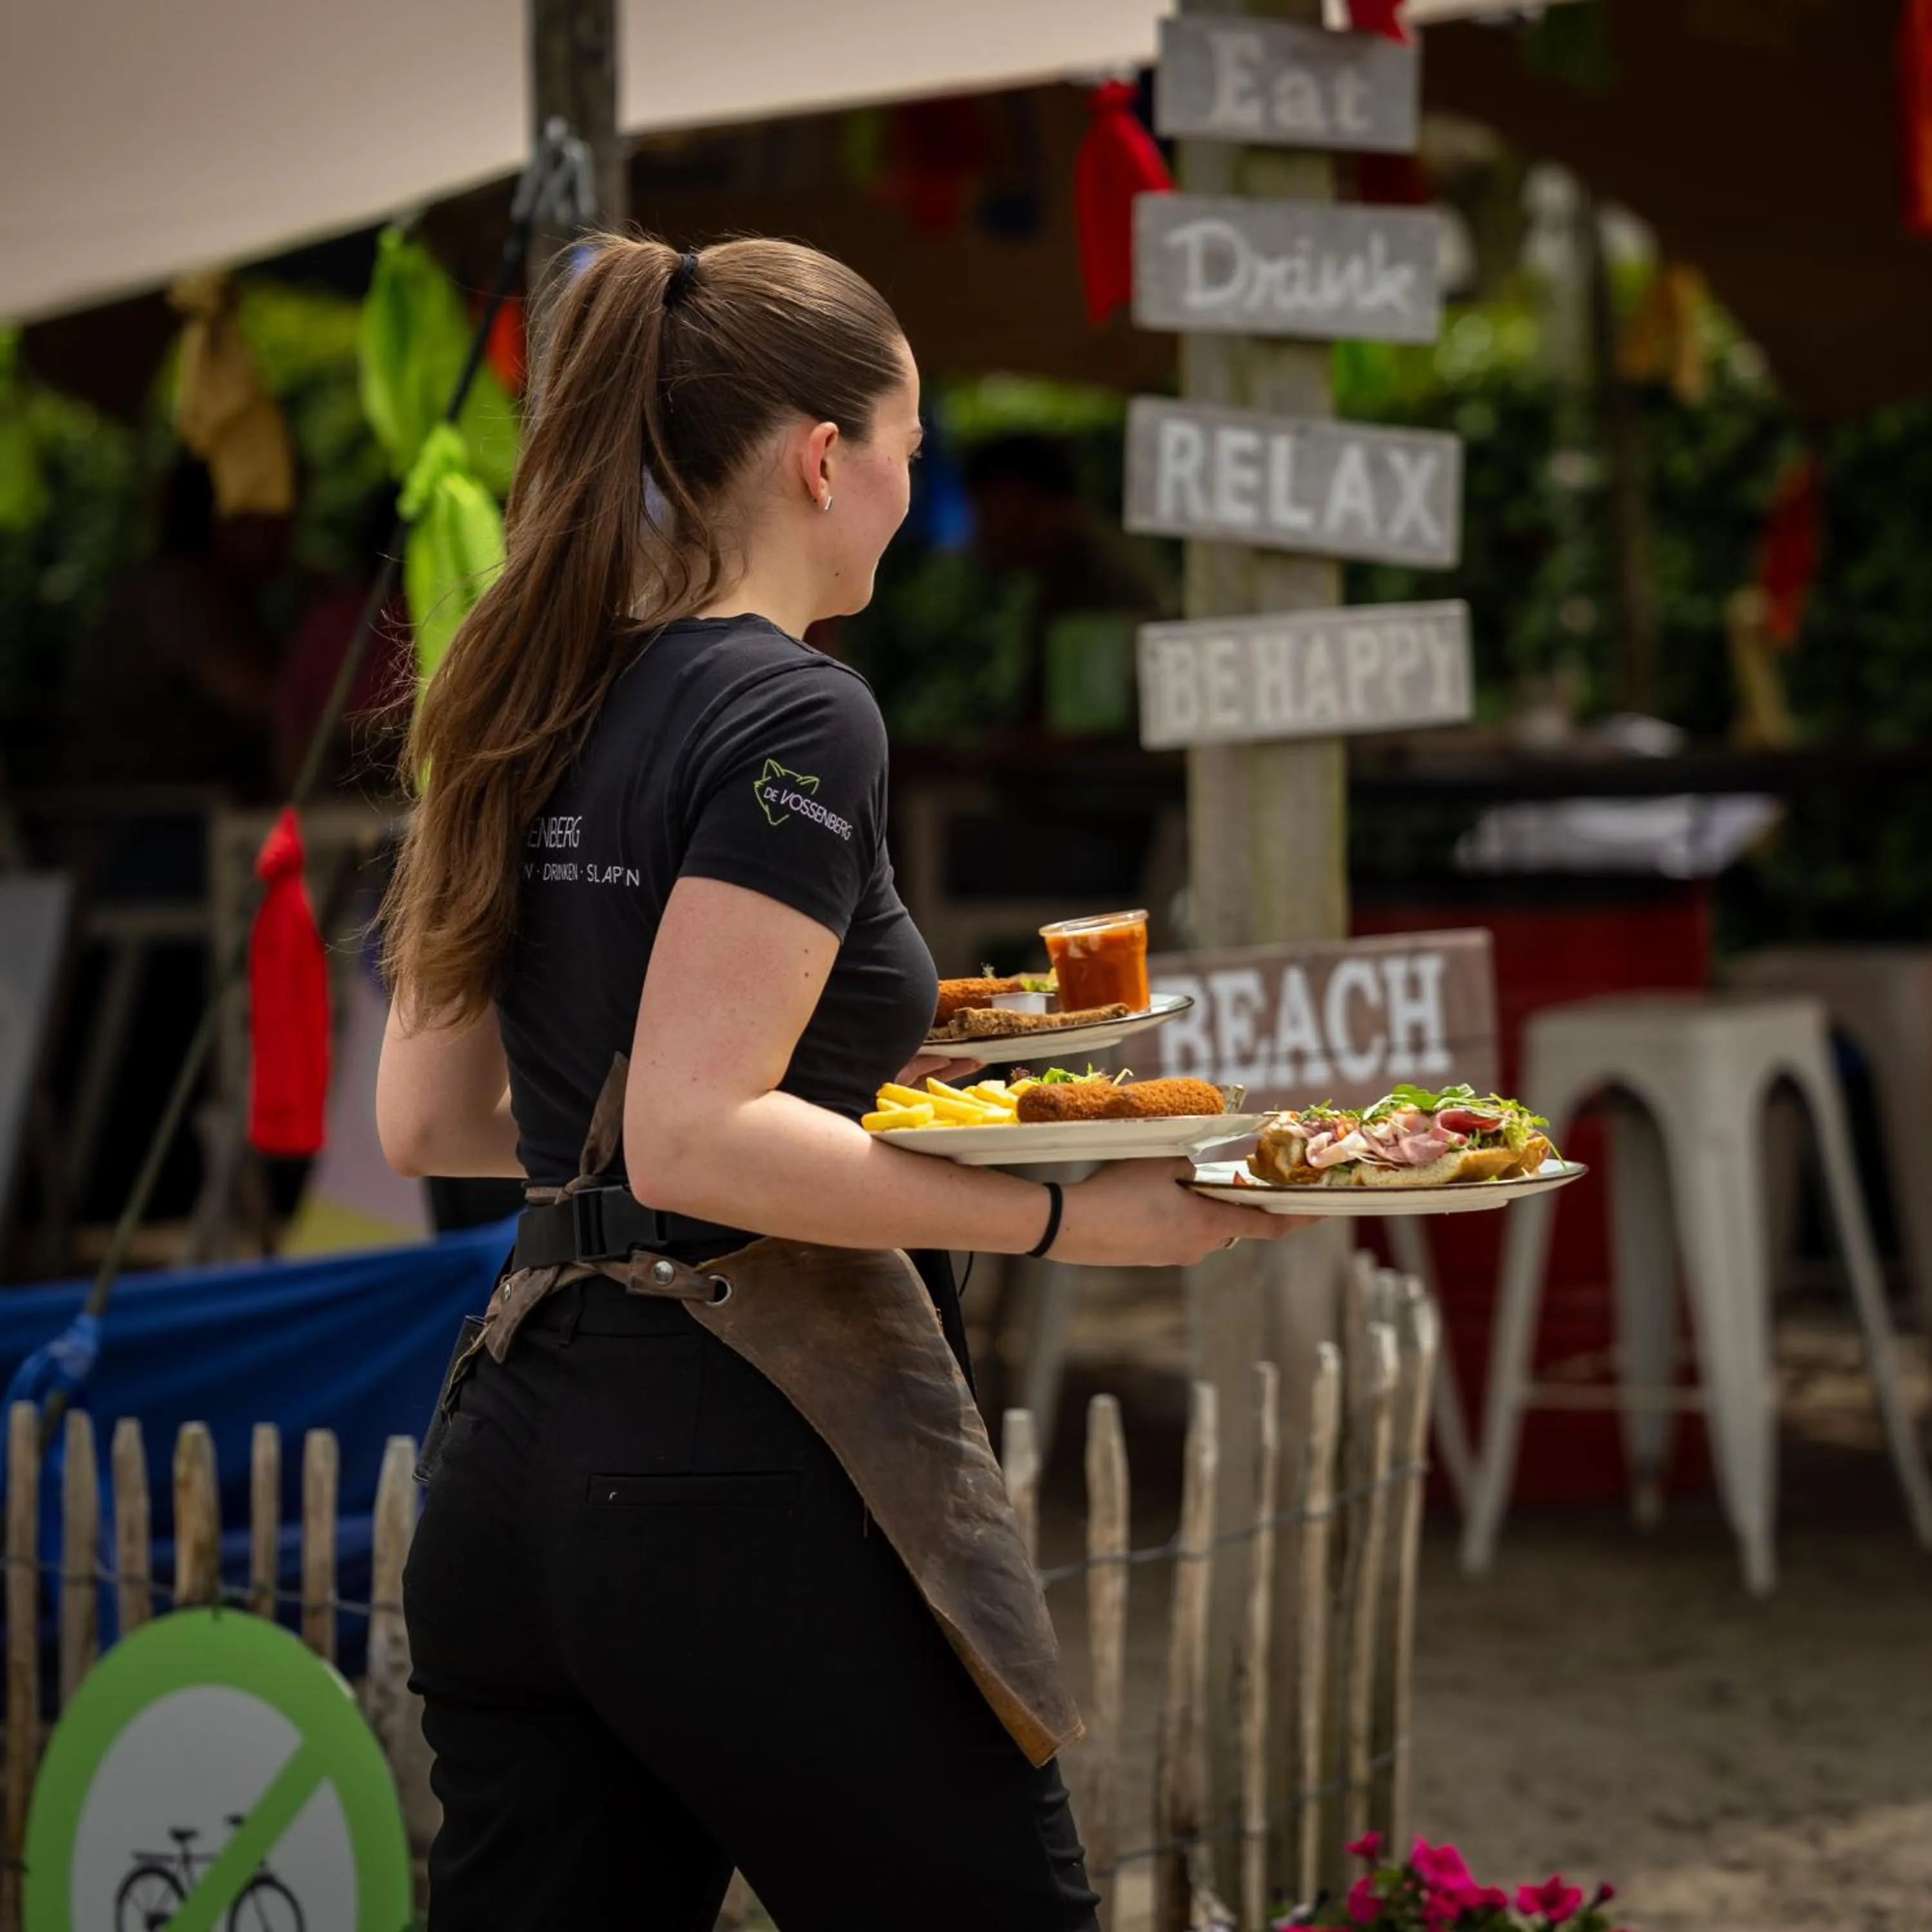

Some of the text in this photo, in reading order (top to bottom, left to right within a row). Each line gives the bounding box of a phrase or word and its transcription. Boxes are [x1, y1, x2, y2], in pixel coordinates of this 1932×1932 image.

[1210, 32, 1373, 131] Eat
[1165, 220, 1417, 312] Drink
[1158, 419, 1443, 545] RELAX
[763, 787, 853, 840] DE VOSSENBERG
[1153, 954, 1452, 1091] BEACH
